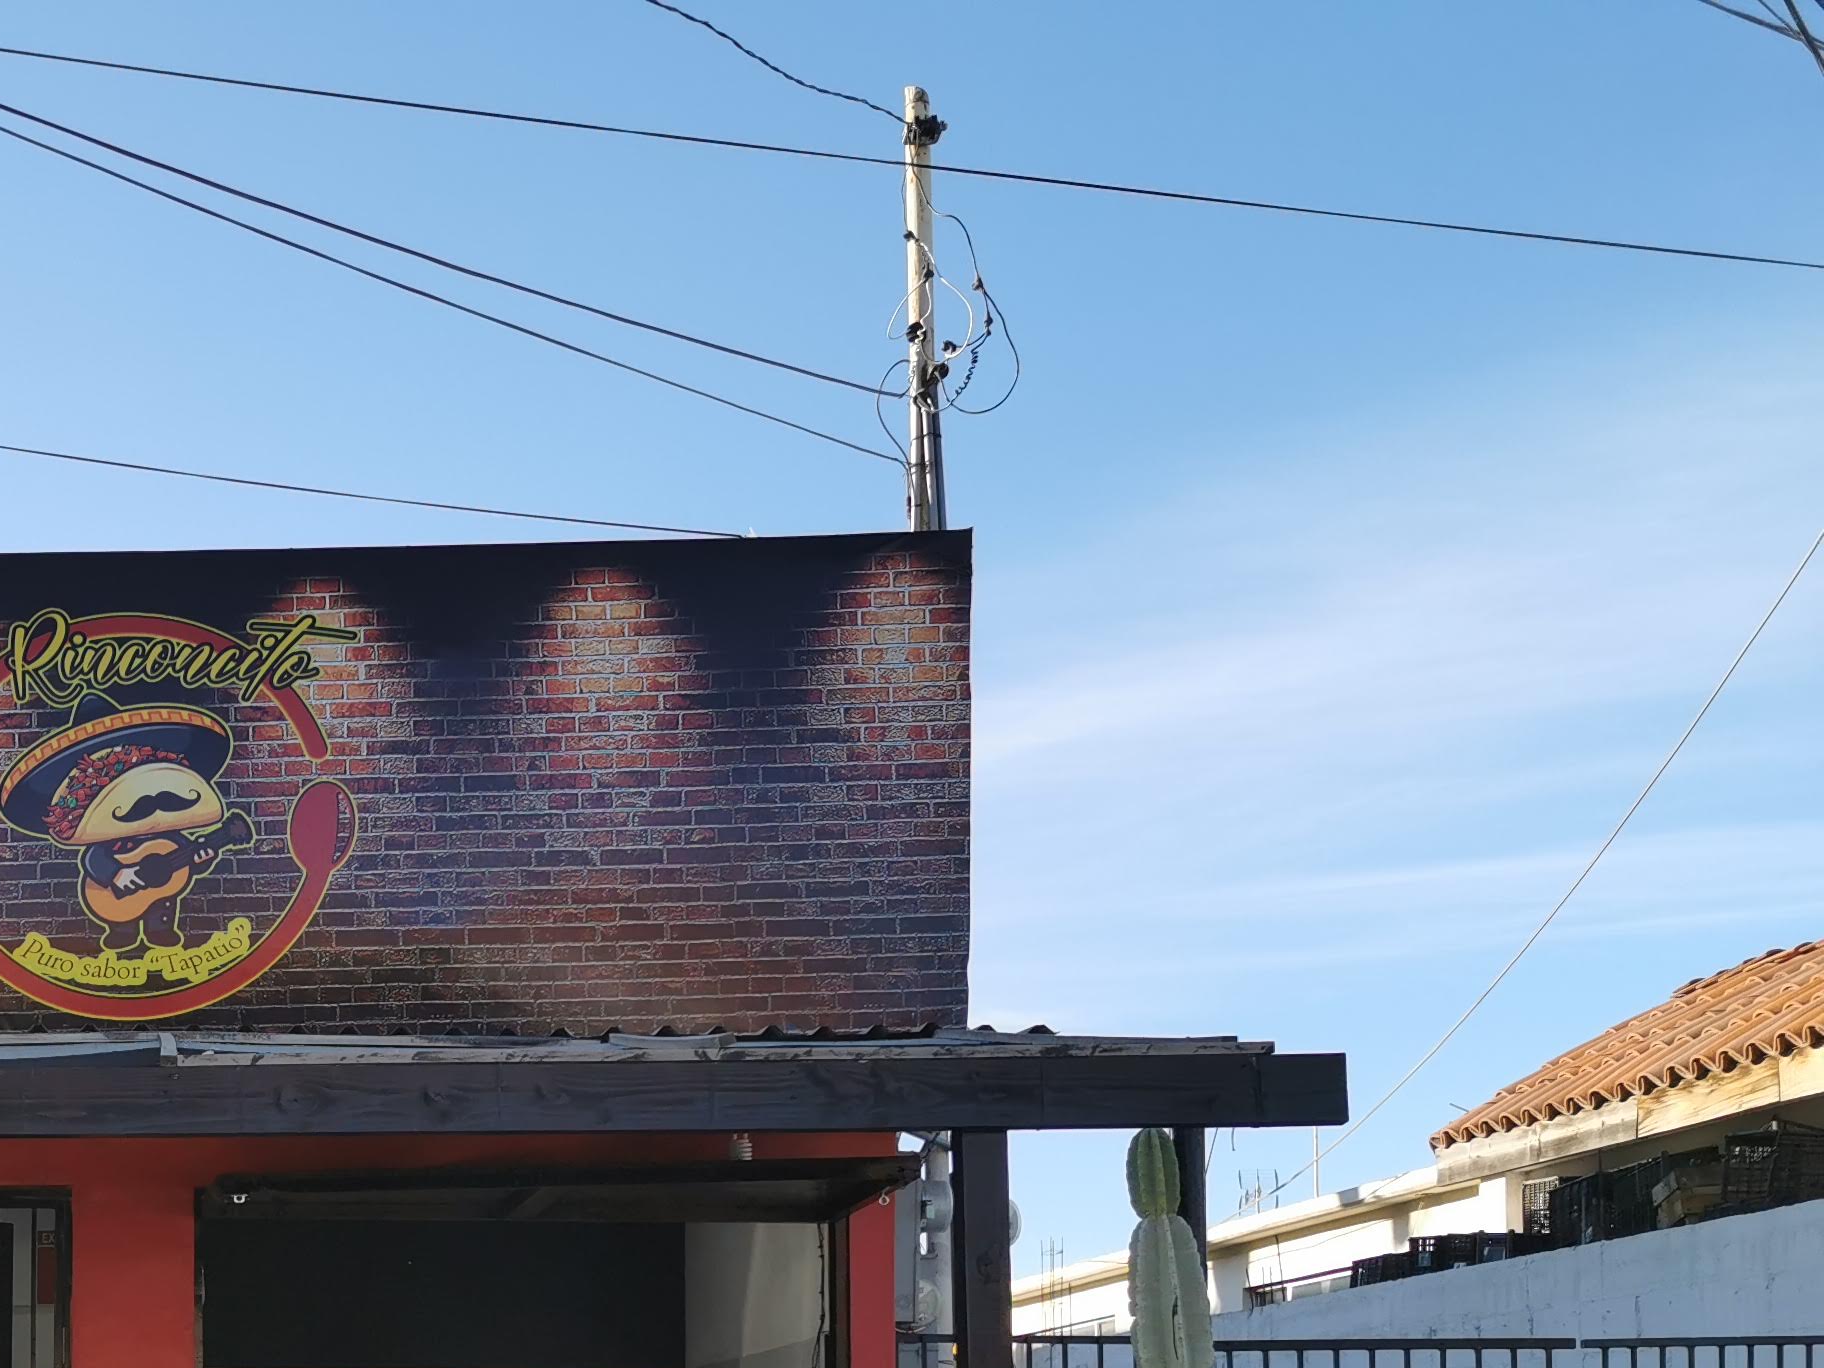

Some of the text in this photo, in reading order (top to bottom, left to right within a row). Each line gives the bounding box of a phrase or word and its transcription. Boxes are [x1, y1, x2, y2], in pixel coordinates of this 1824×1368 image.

[8, 609, 358, 703] Rinconcito
[21, 938, 74, 973] Puro
[80, 958, 141, 979] sabor
